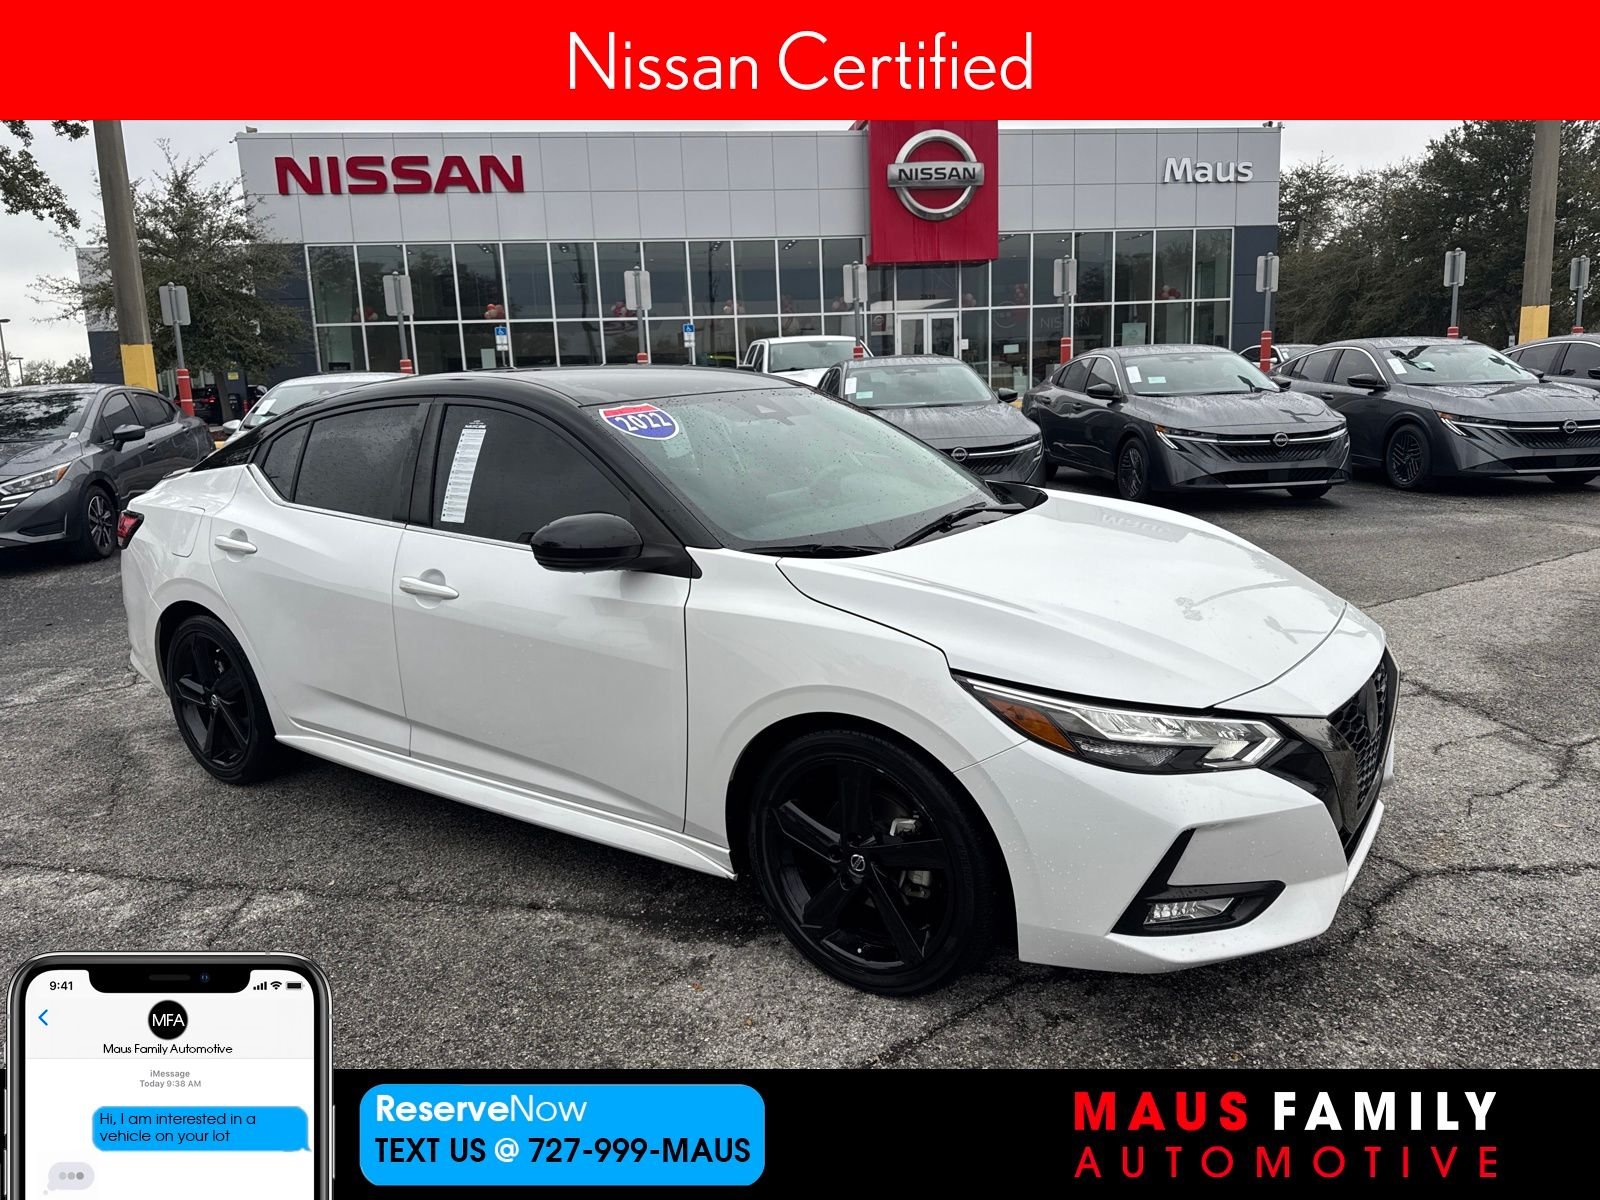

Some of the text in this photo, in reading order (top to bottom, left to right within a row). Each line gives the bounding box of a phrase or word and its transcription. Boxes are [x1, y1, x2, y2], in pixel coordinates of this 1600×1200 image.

[275, 155, 524, 196] NISSAN
[898, 166, 976, 182] NISSAN
[1163, 156, 1254, 183] Maus
[615, 412, 673, 432] 2022
